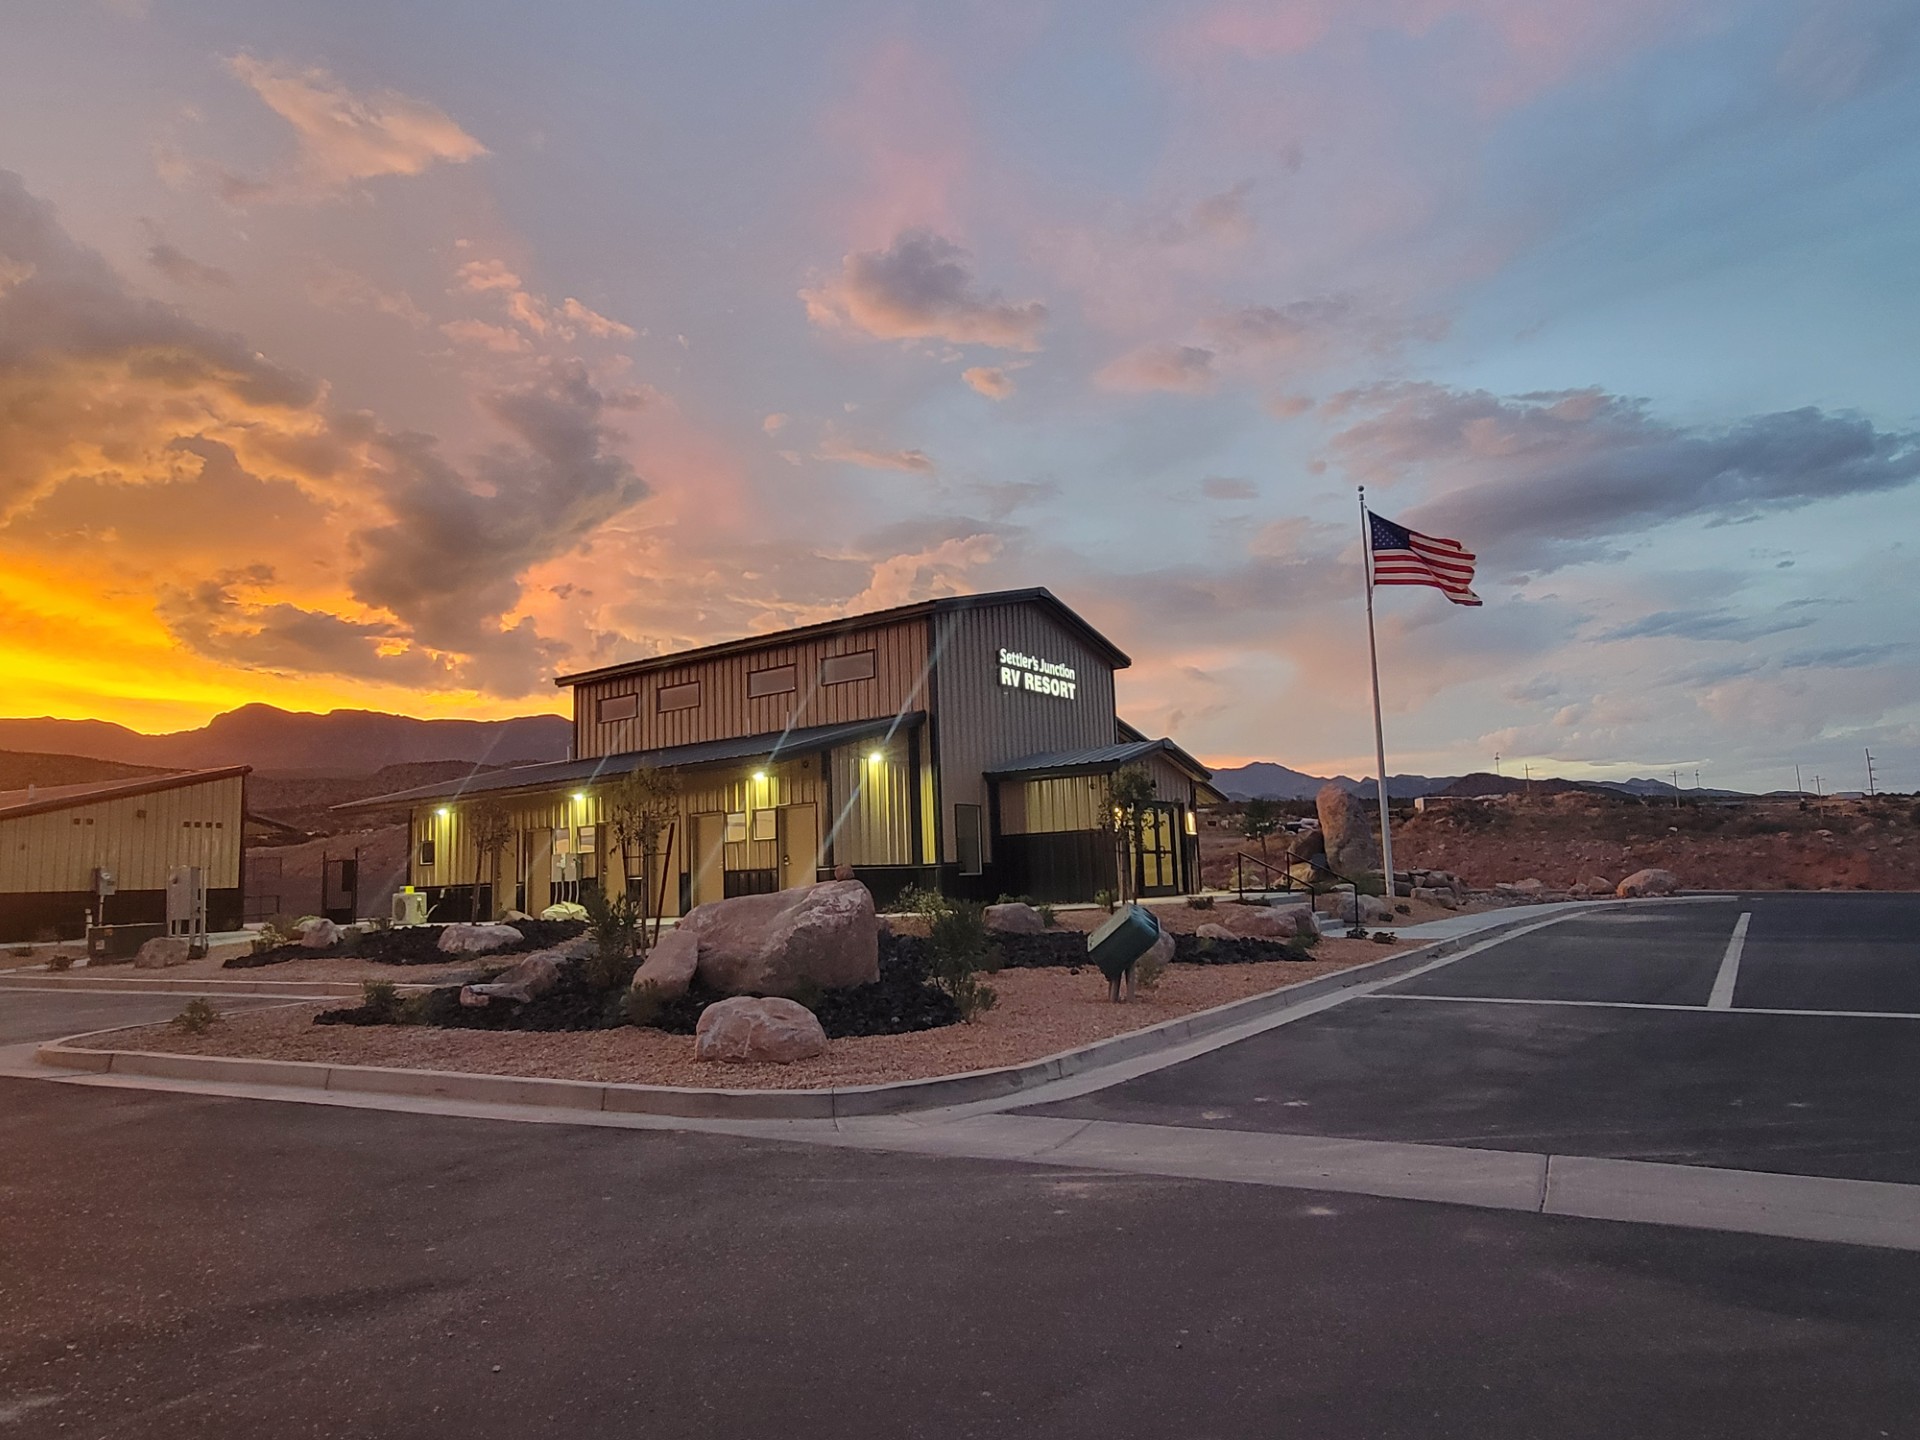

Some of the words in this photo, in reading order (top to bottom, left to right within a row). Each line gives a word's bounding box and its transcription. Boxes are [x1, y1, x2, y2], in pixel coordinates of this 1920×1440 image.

[999, 648, 1039, 672] Settler's
[1039, 658, 1076, 681] Junction
[1001, 666, 1021, 688] RV
[1024, 672, 1076, 700] RESORT
